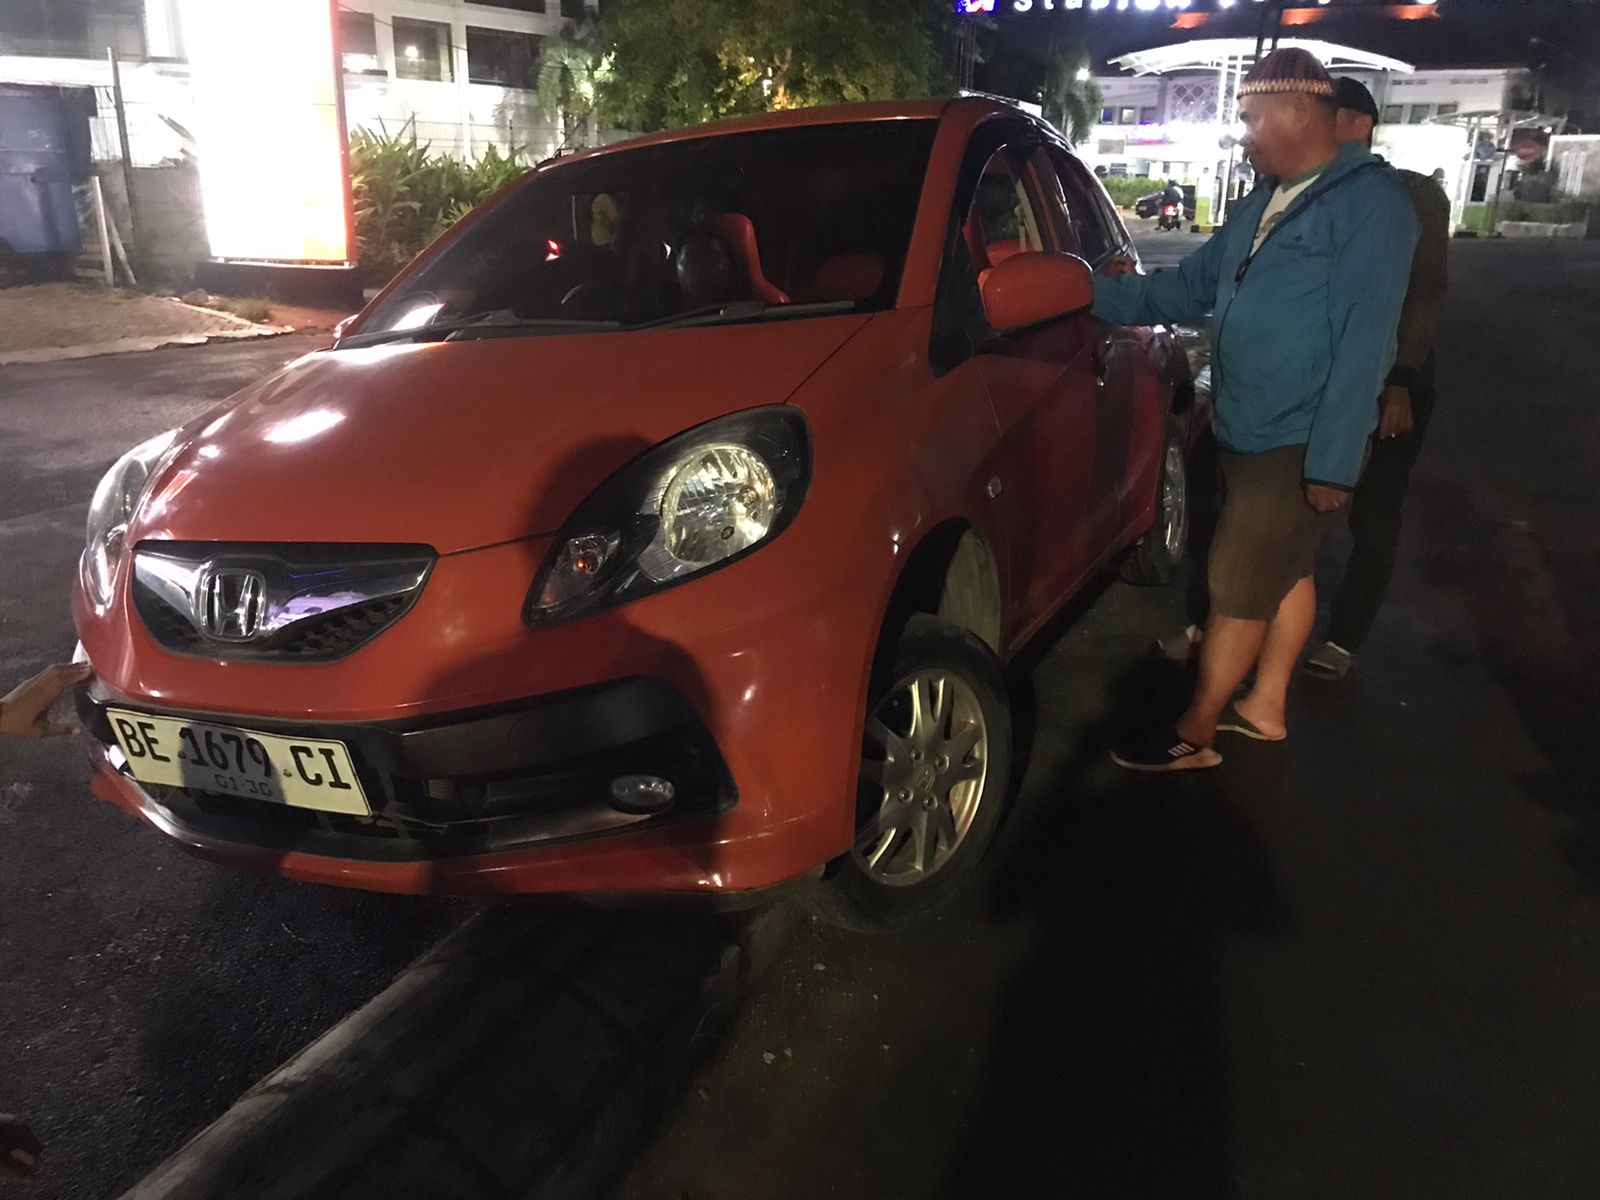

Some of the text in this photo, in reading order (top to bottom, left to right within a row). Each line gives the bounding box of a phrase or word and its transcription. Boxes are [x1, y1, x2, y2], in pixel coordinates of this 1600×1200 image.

[115, 717, 352, 790] BE 1679 CI
